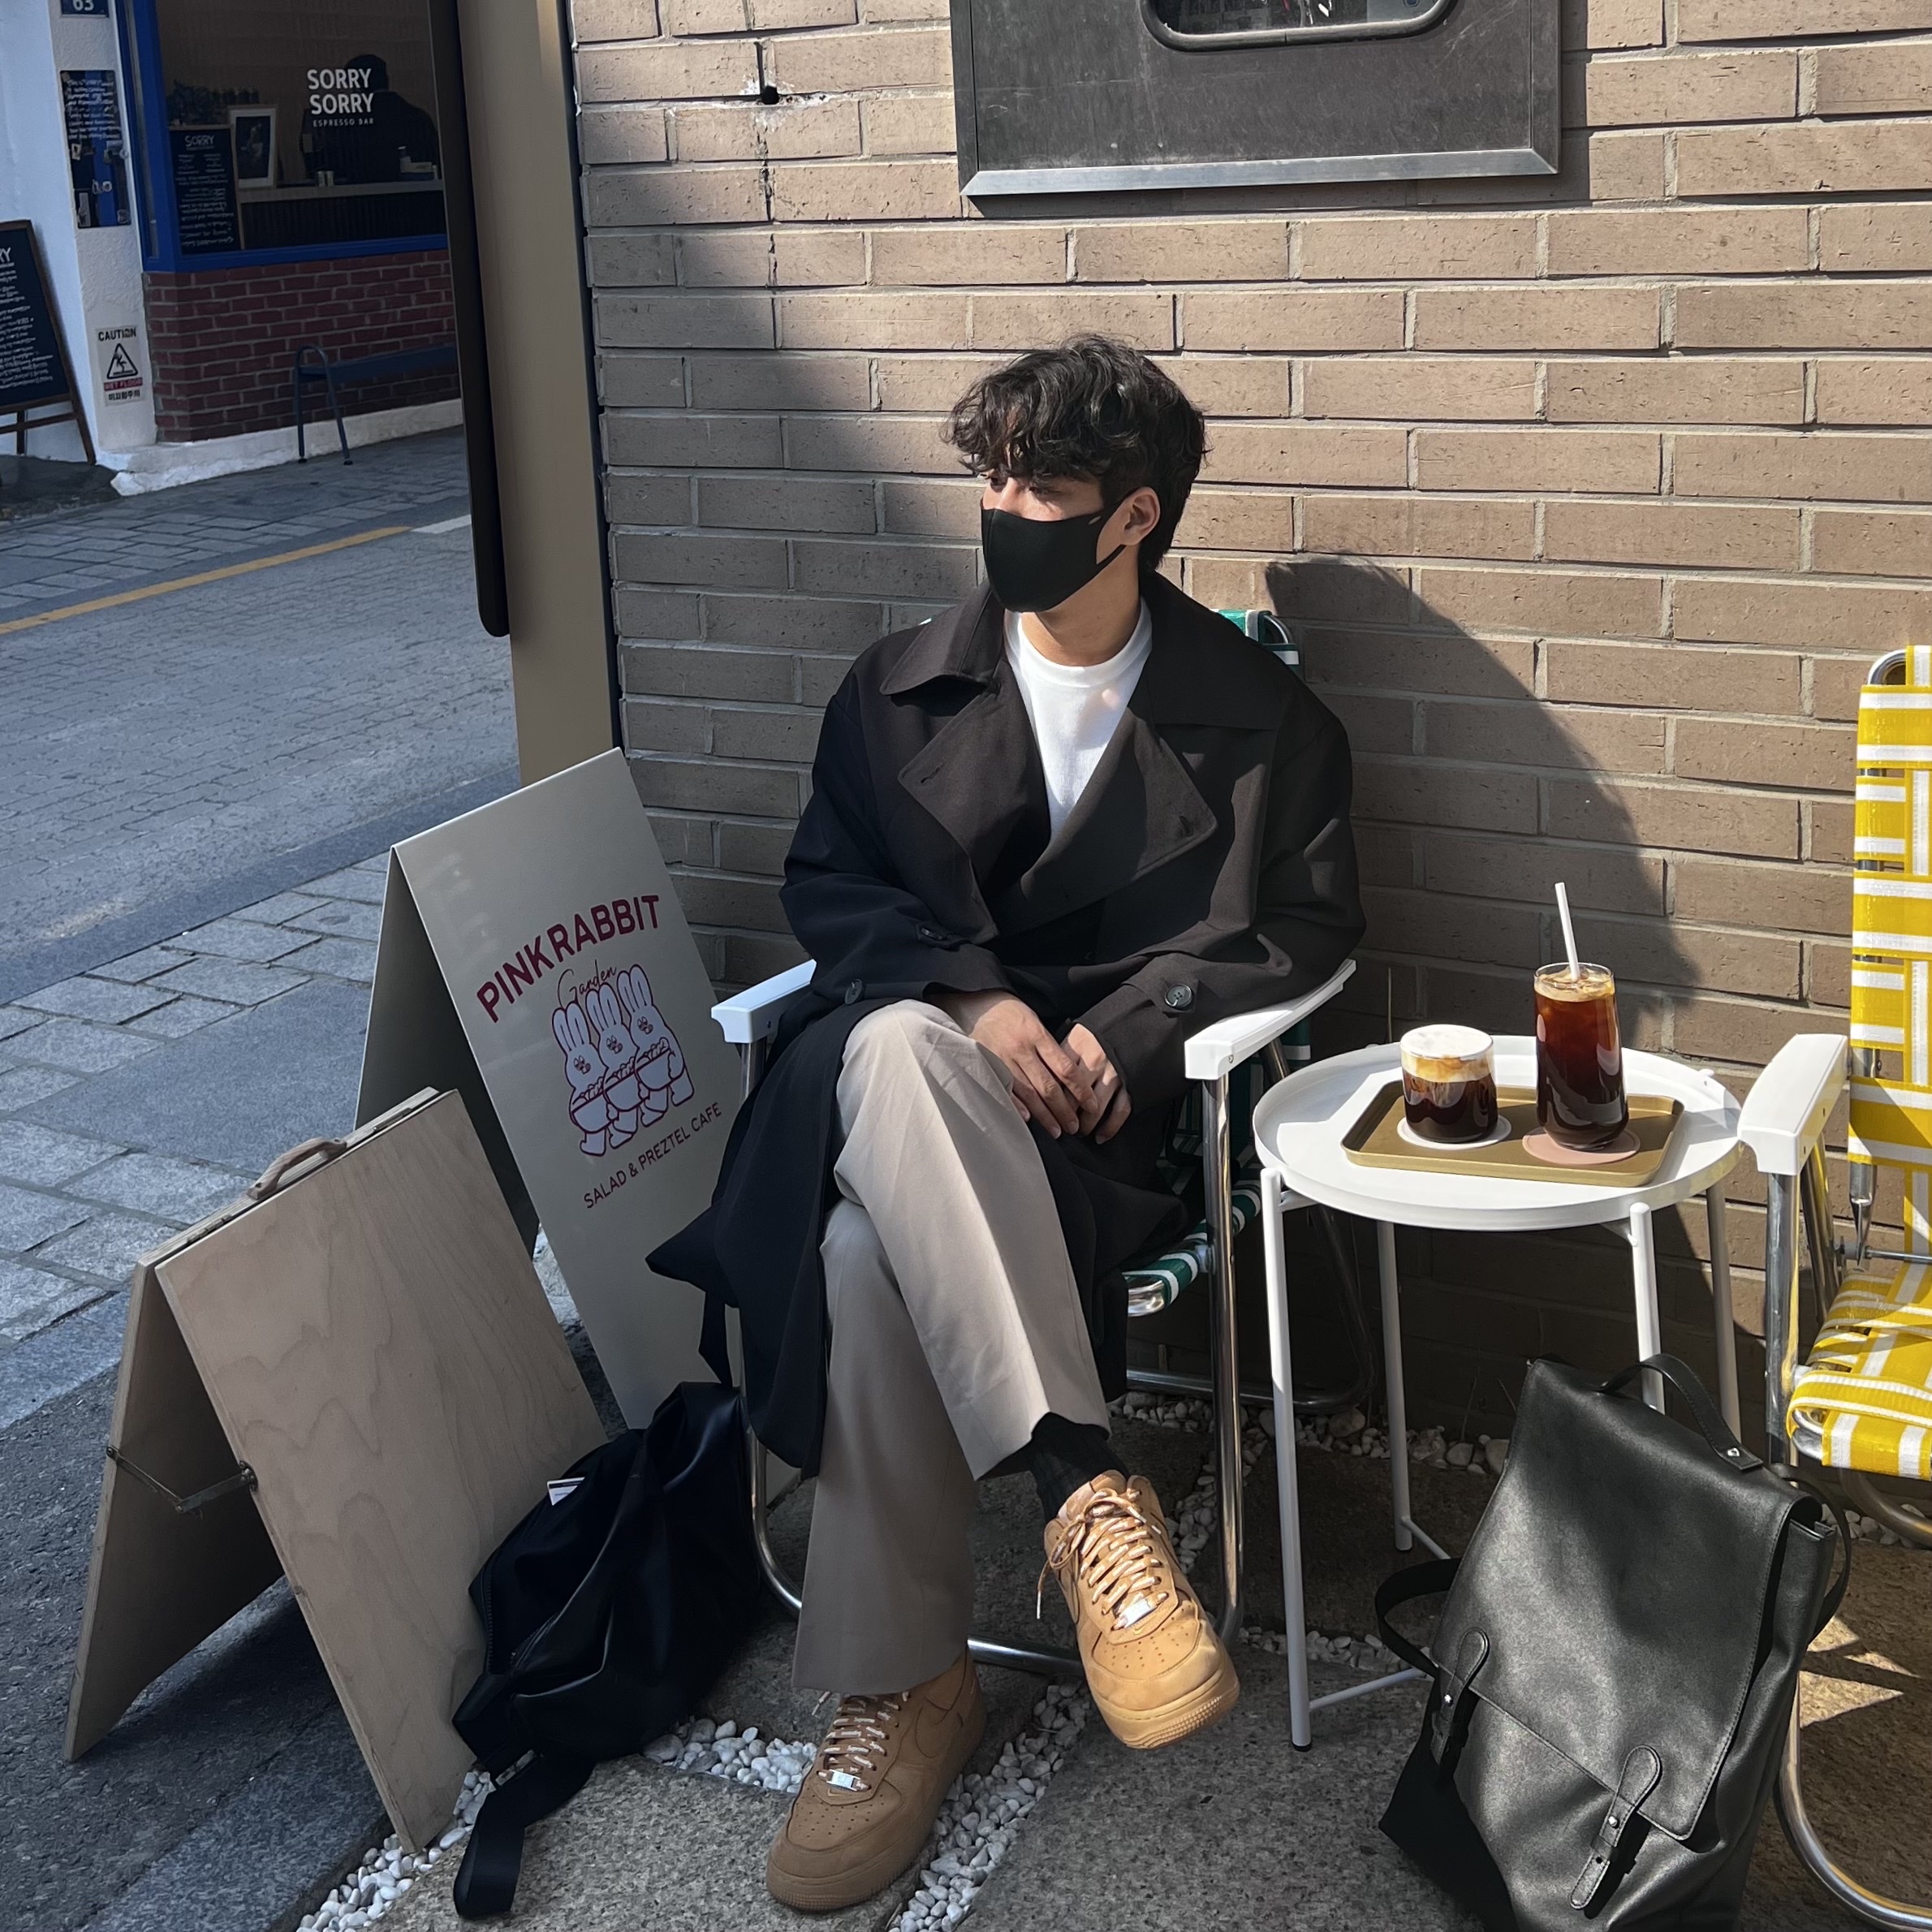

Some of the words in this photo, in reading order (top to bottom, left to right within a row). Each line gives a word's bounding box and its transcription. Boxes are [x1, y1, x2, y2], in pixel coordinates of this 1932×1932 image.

[307, 68, 372, 89] SORRY
[309, 93, 374, 115] SORRY
[313, 119, 355, 127] ESPRESSO
[358, 118, 374, 126] BAR
[98, 327, 136, 342] CAUTION
[557, 959, 618, 1008] Garden
[583, 1170, 627, 1209] SALAD
[627, 1162, 640, 1178] &
[637, 1127, 691, 1171] PREZTEL
[690, 1102, 722, 1132] CAFE
